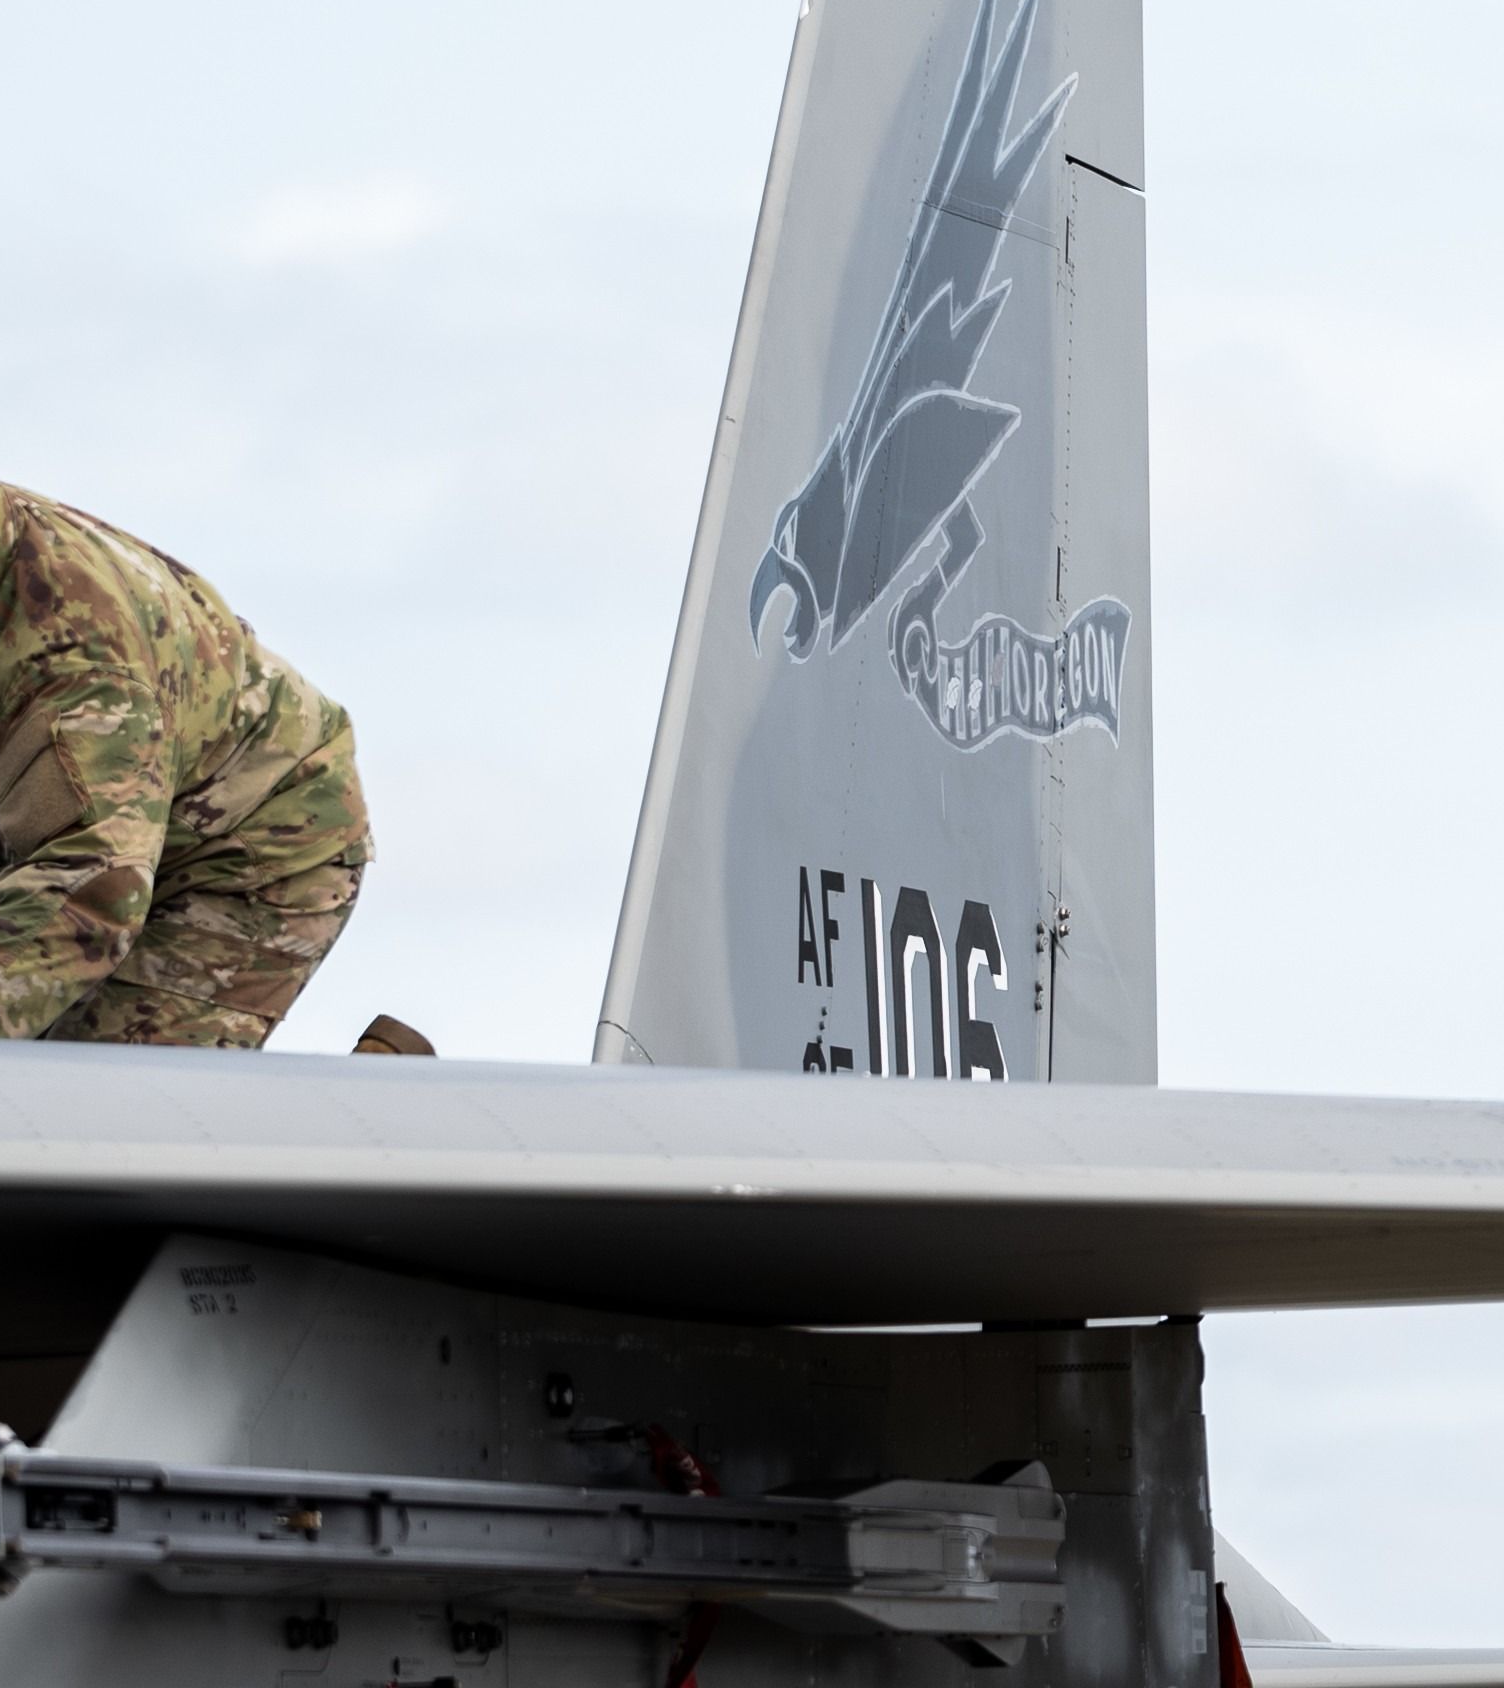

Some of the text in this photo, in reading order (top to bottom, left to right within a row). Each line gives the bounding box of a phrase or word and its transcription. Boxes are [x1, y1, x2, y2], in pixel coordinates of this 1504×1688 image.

[1012, 622, 1119, 722] OREGON
[797, 865, 846, 988] AF
[860, 877, 1009, 1083] 106
[225, 1293, 239, 1314] 2
